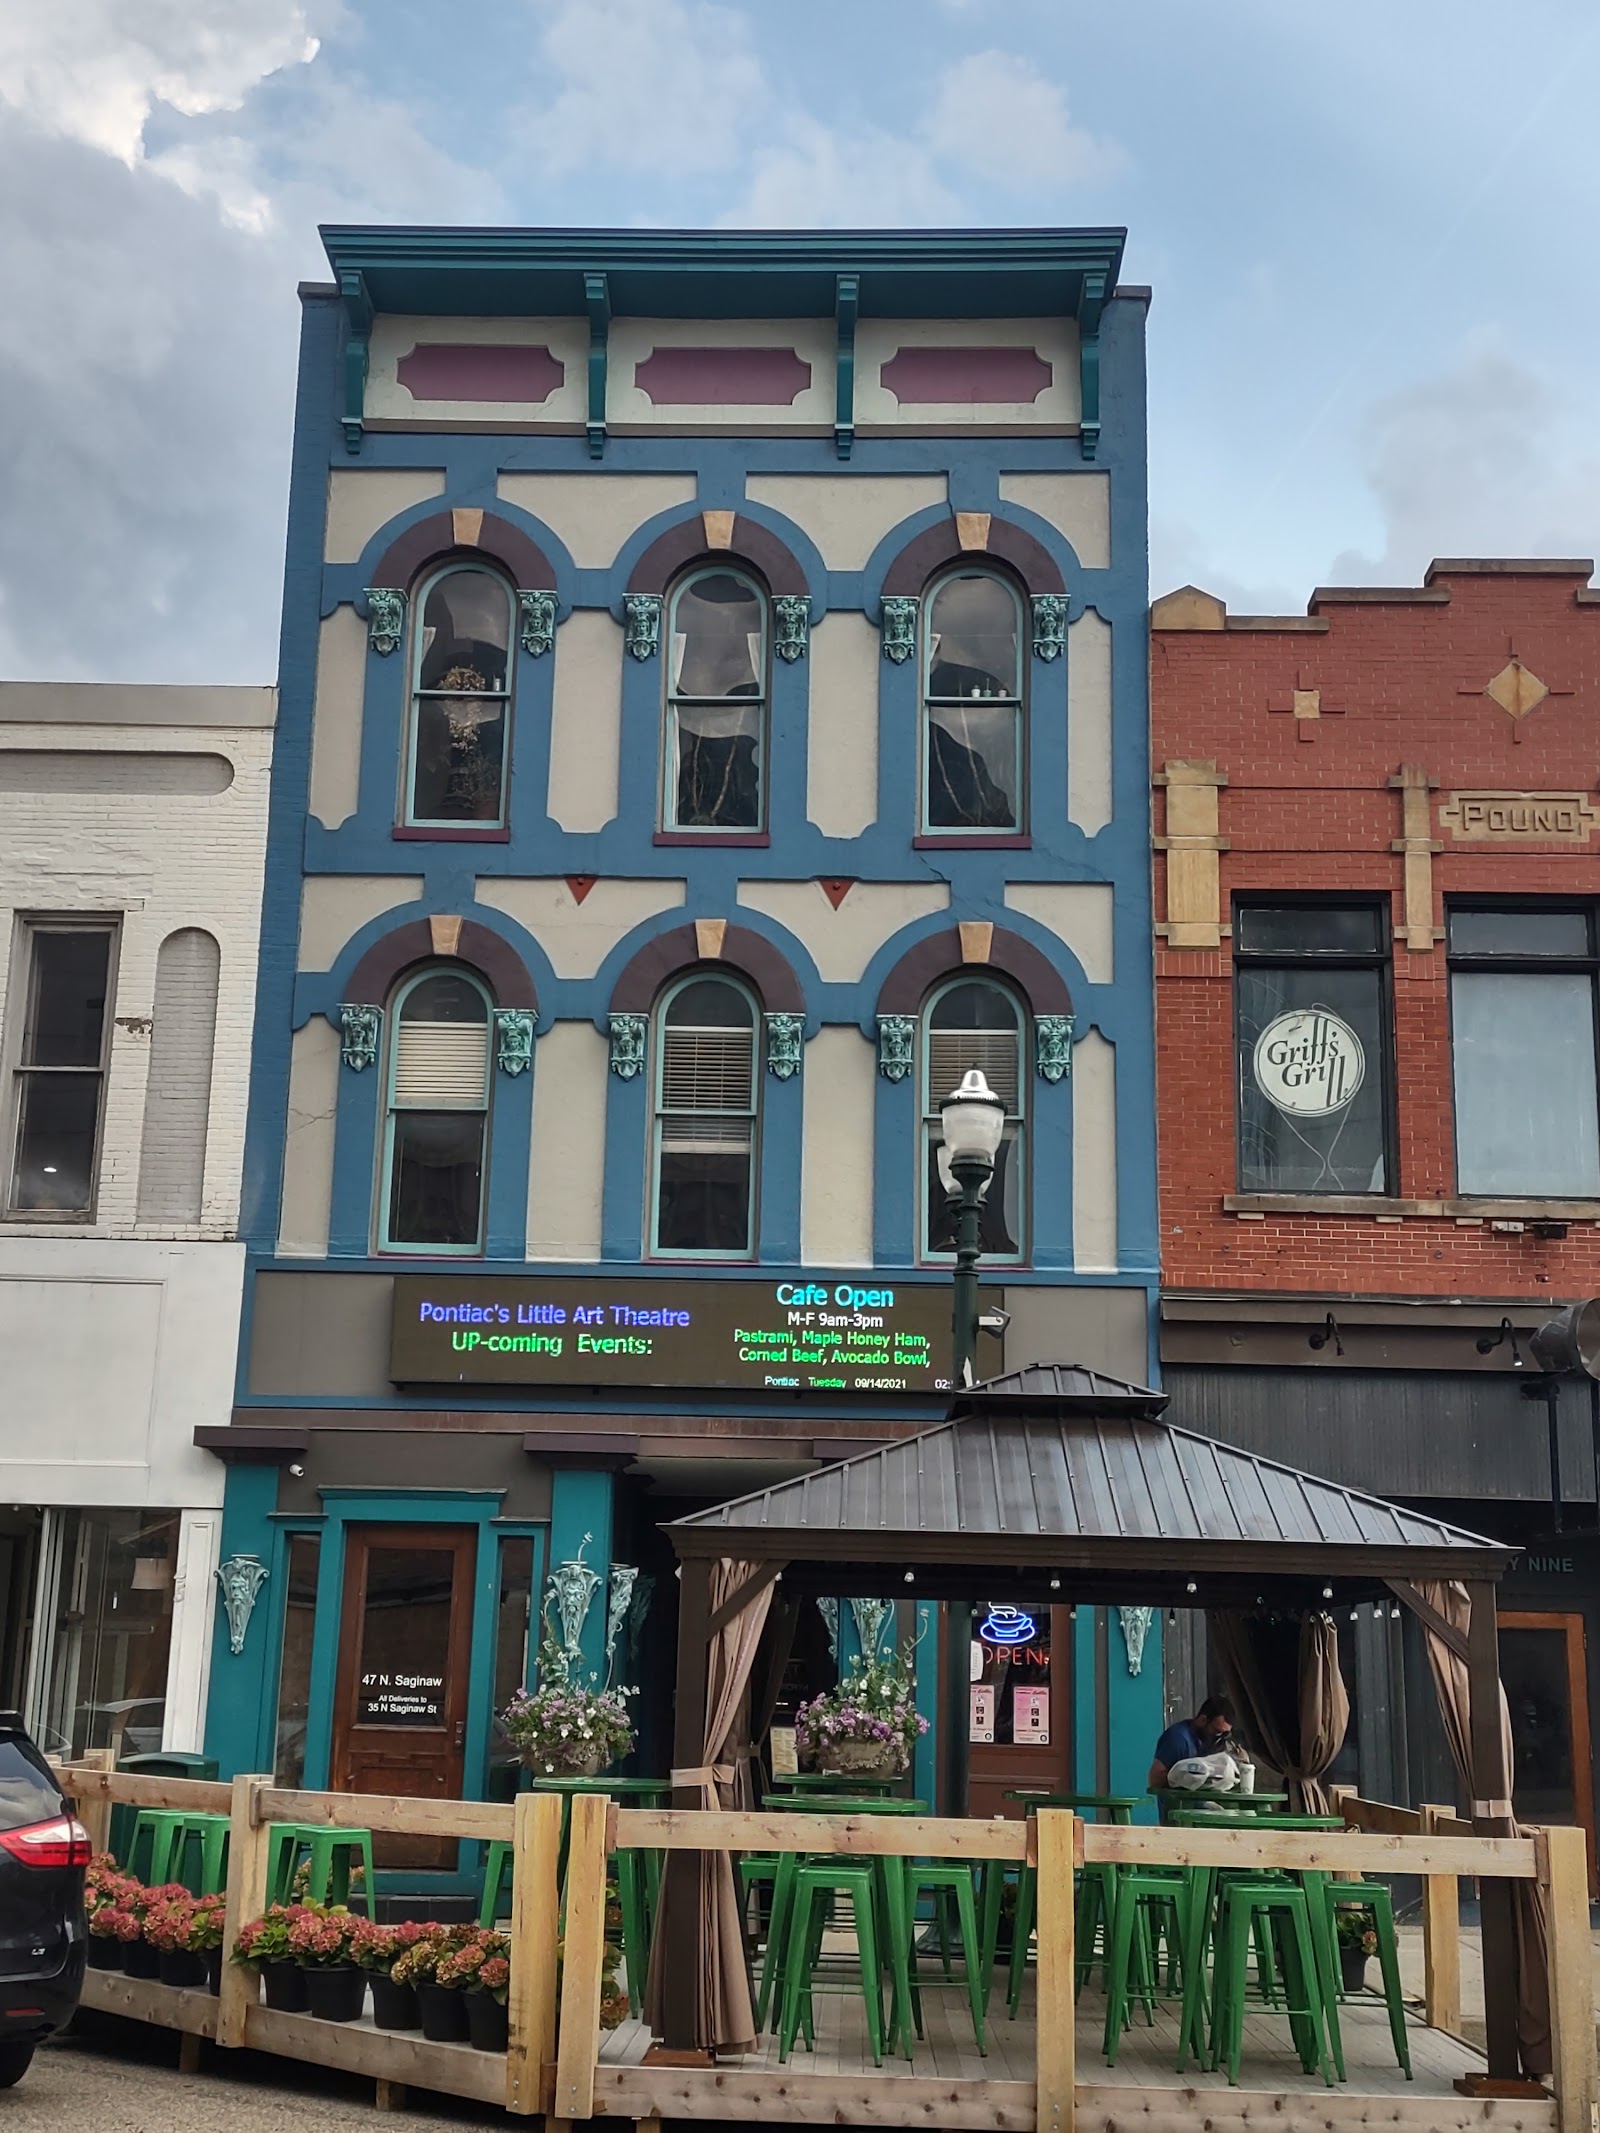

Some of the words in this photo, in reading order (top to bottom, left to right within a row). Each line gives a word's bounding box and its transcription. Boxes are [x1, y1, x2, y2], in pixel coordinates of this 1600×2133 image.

[1463, 804, 1574, 831] POUND
[1267, 1016, 1339, 1066] Griff's
[1281, 1055, 1346, 1108] Grill
[776, 1284, 828, 1306] Cafe
[834, 1285, 894, 1311] Open
[420, 1302, 510, 1324] Pontiac's
[517, 1304, 566, 1325] Little
[573, 1305, 604, 1326] Art
[609, 1306, 690, 1327] Theatre
[787, 1311, 815, 1326] M-F
[818, 1313, 883, 1330] 9am-3pm
[452, 1331, 563, 1357] UP-coming
[577, 1333, 653, 1355] Events:
[734, 1329, 797, 1346] Pastrami,
[802, 1331, 842, 1347] Maple
[847, 1332, 890, 1349] Honey
[894, 1333, 930, 1349] Ham,
[739, 1347, 787, 1363] Corned
[792, 1349, 827, 1366] Beef,
[831, 1350, 889, 1365] Avocado
[894, 1351, 930, 1368] Bowl,
[764, 1375, 799, 1387] Pontiac
[808, 1376, 847, 1388] Tuesday
[855, 1378, 906, 1390] 09/14/2021
[934, 1378, 953, 1390] 02:
[1528, 1556, 1574, 1573] NINE
[362, 1674, 377, 1685] 47
[379, 1674, 391, 1686] N.
[394, 1674, 442, 1689] Saginaw
[367, 1703, 379, 1712] 35
[380, 1703, 388, 1712] N
[390, 1703, 426, 1715] Saginaw
[427, 1704, 437, 1714] St
[388, 1695, 419, 1703] Deliveries
